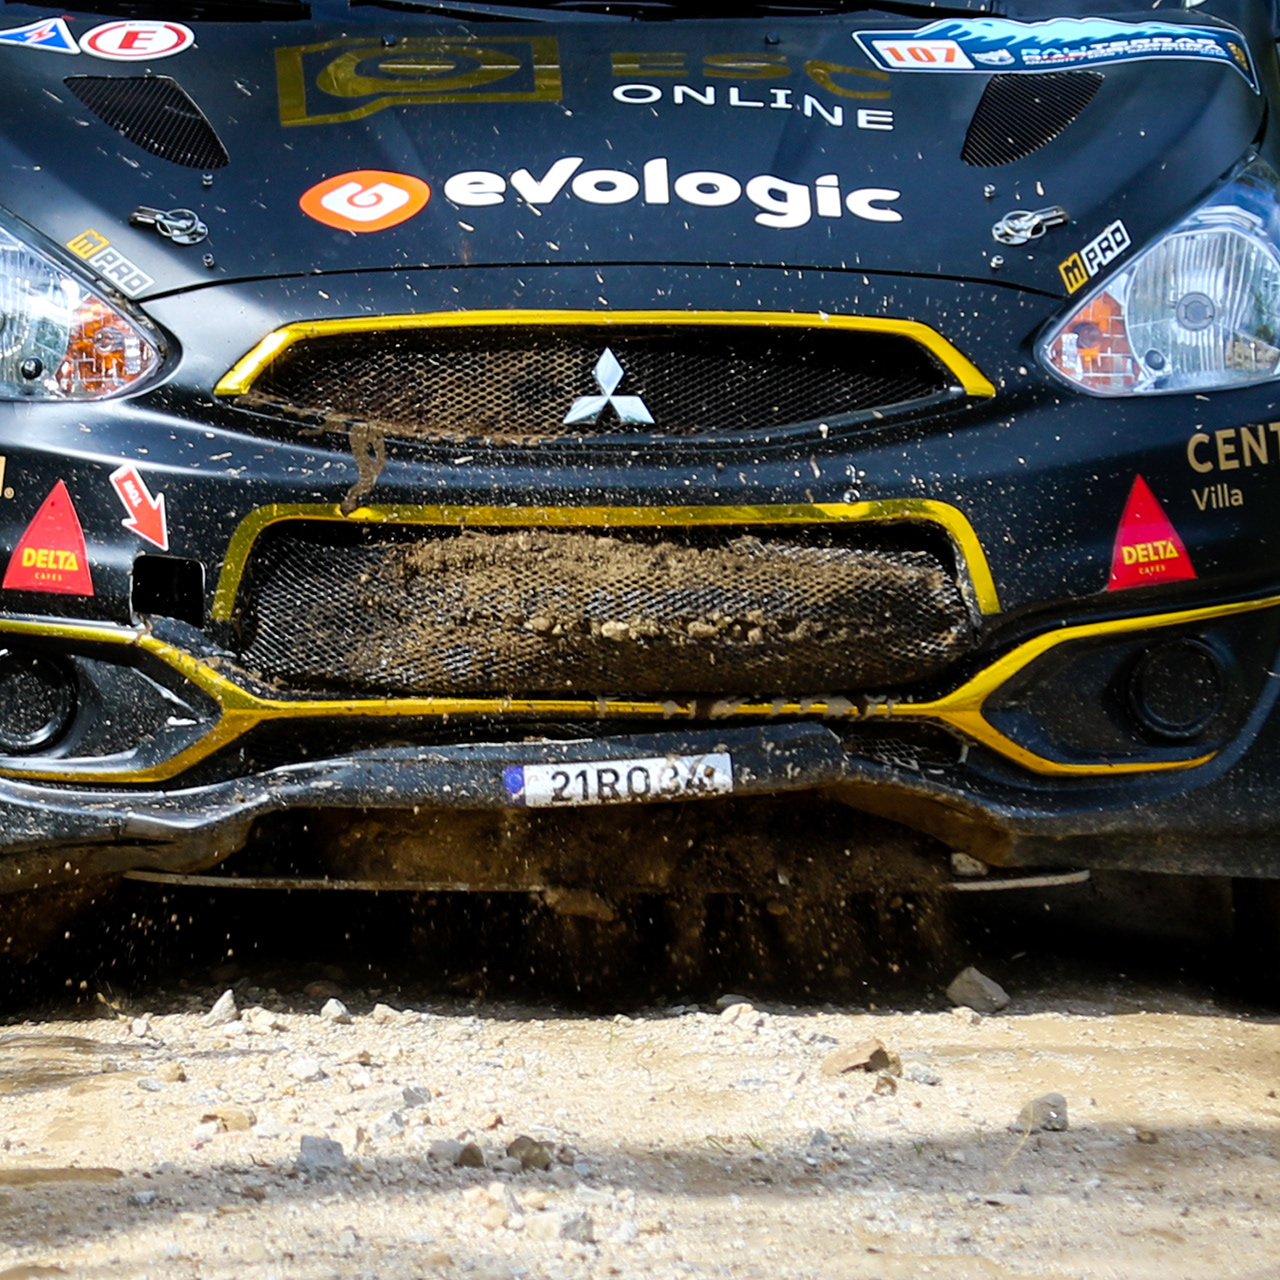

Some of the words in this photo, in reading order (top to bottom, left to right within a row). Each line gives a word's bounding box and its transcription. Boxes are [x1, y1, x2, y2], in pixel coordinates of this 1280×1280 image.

[117, 30, 158, 51] E
[881, 47, 956, 63] 107
[611, 52, 892, 100] ESC
[612, 83, 895, 132] ONLINE
[122, 479, 144, 508] TOW
[1191, 483, 1244, 511] Villa
[22, 546, 80, 571] DELTA
[1121, 539, 1180, 566] DELTA
